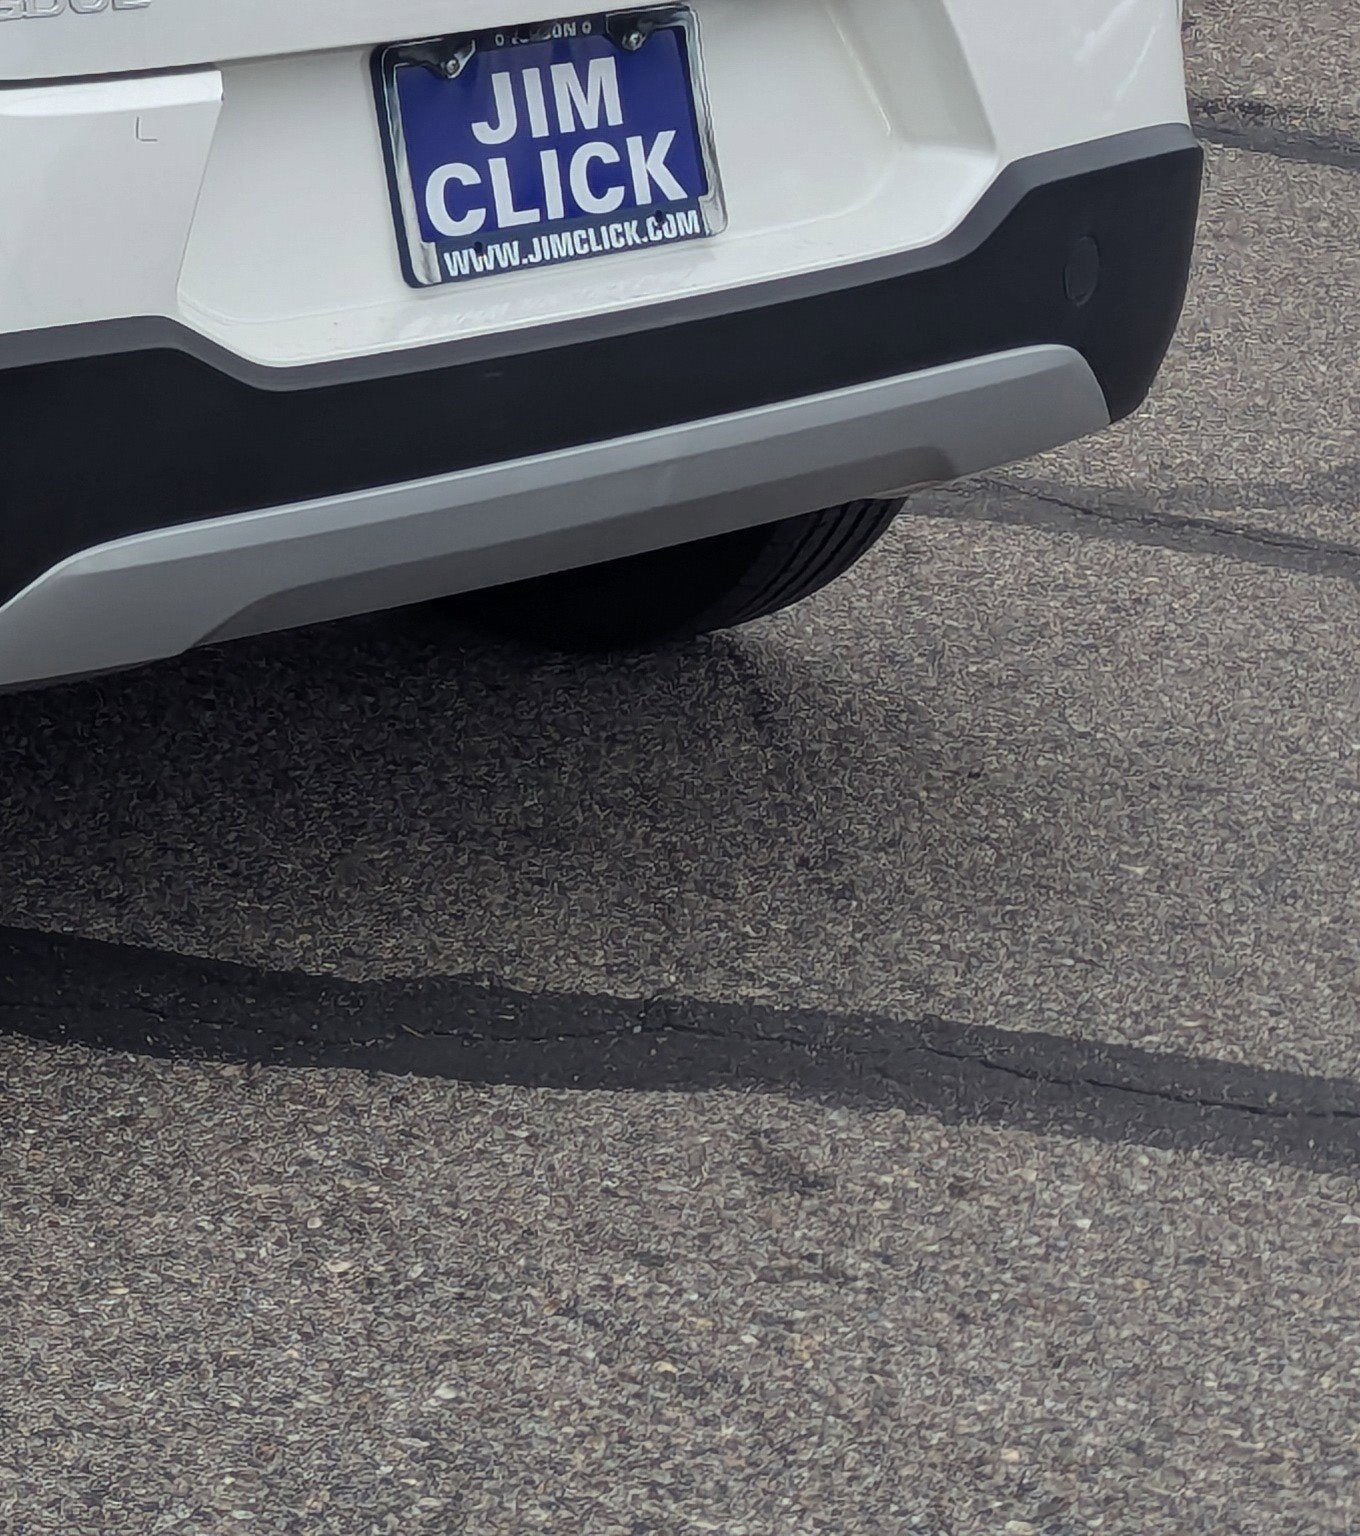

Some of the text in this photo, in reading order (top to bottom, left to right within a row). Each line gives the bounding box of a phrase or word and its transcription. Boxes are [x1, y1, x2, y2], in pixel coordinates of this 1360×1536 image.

[471, 56, 623, 145] JIM
[425, 130, 688, 237] CLICK
[443, 210, 701, 277] WWW.JIMCLICK.COM
